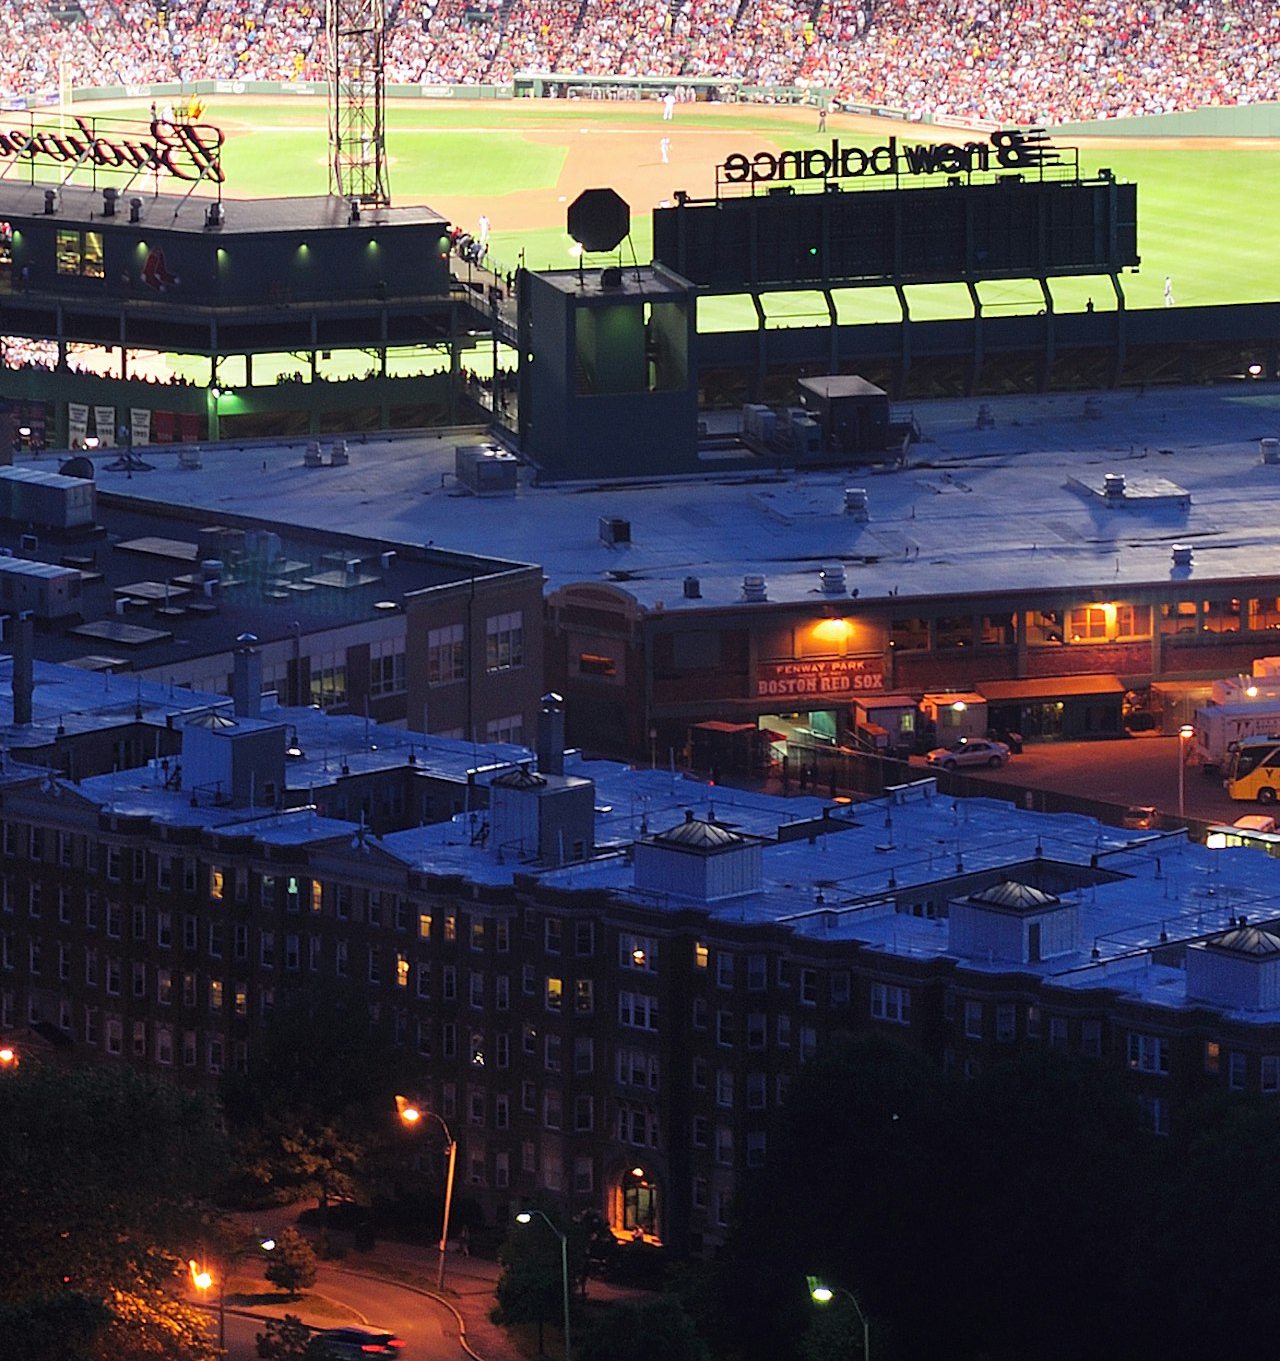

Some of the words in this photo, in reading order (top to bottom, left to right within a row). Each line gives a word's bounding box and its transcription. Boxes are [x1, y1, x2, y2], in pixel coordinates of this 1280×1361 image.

[777, 664, 826, 675] FENWAY
[831, 660, 865, 672] PARK
[758, 677, 817, 695] BOSTON
[820, 676, 850, 691] RED
[854, 674, 883, 689] SOX
